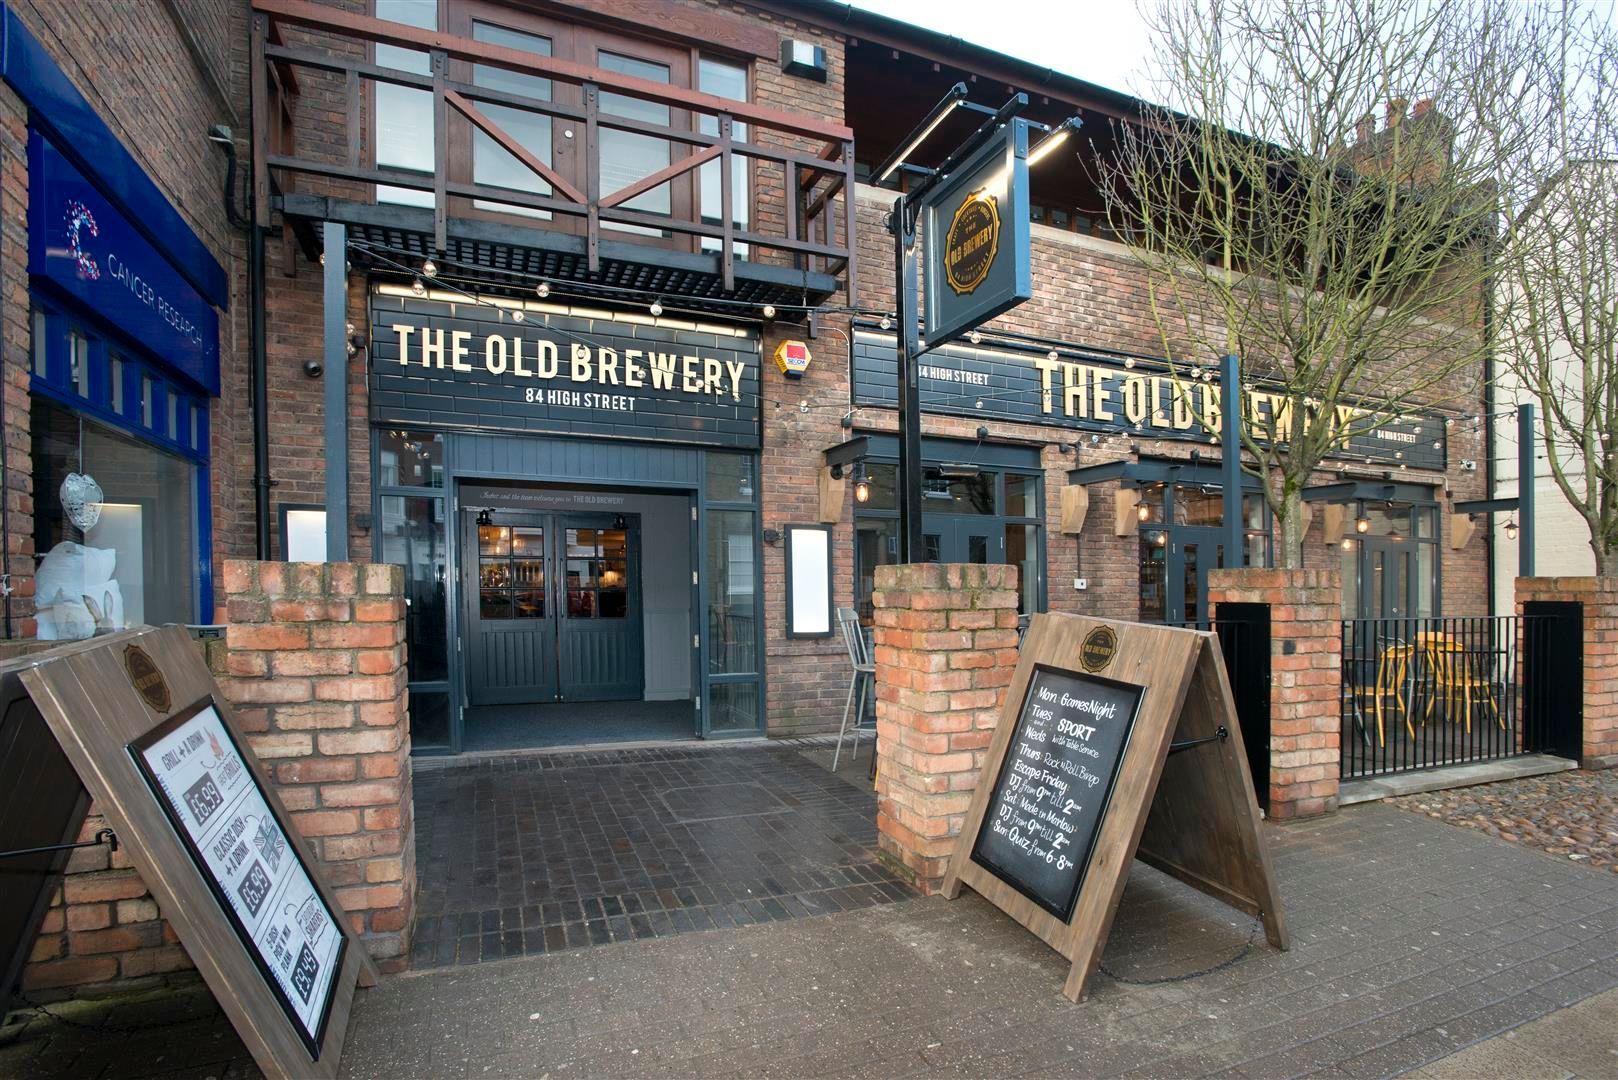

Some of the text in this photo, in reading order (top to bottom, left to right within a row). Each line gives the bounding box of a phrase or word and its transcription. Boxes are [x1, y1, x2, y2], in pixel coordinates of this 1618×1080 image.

[951, 246, 962, 266] OLD
[963, 223, 993, 257] BREWERY
[108, 253, 203, 348] CANCER RESEARCH
[393, 324, 745, 401] THE OLD BREWERY
[930, 366, 953, 381] HIGH
[954, 369, 989, 386] STREET
[525, 387, 636, 411] 84 HIGH STREET
[1034, 359, 1114, 421] THE
[1124, 373, 1194, 431] OLD
[1397, 432, 1417, 443] STREET
[573, 495, 584, 503] THE
[584, 495, 596, 504] OLD
[596, 496, 625, 505] BREWERY
[1032, 704, 1053, 720] Tues
[1060, 693, 1089, 712] Games
[1088, 700, 1117, 720] Night
[1025, 725, 1099, 759] Weds with Table Service
[1057, 718, 1096, 741] SPORT
[161, 730, 206, 771] GRILL + A DRINK
[223, 755, 241, 780] GRILLS
[1014, 759, 1041, 780] Escape
[1043, 752, 1060, 769] Rock
[1064, 760, 1079, 777] Roll
[1079, 765, 1100, 787] Bingo
[1009, 773, 1022, 791] DJ
[1018, 779, 1036, 795] from
[1050, 791, 1065, 809] till
[999, 803, 1012, 822] DJ
[1010, 811, 1028, 828] from
[1040, 826, 1054, 843] till
[1038, 809, 1046, 820] in
[213, 816, 247, 861] CLASSIC DISH
[1008, 826, 1031, 850] Quiz
[1027, 839, 1047, 856] from
[225, 839, 250, 877] + A DRINK
[305, 910, 324, 939] SHARERS
